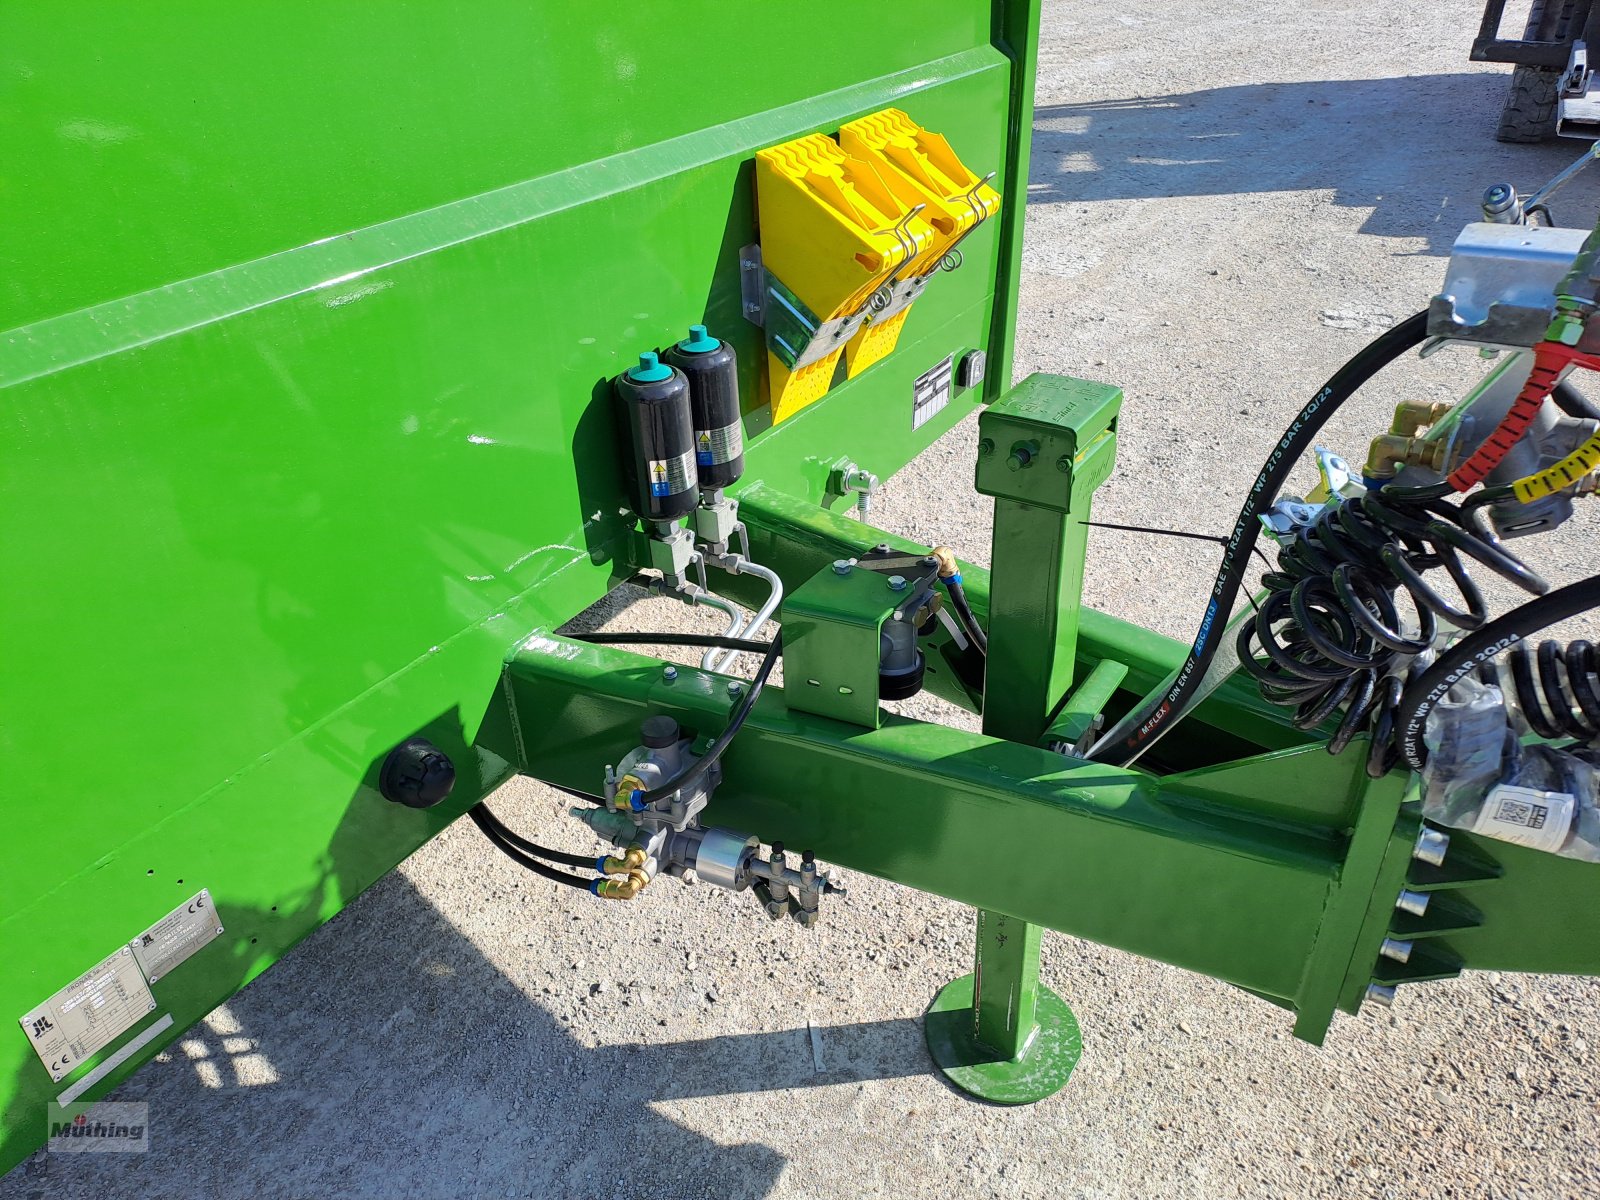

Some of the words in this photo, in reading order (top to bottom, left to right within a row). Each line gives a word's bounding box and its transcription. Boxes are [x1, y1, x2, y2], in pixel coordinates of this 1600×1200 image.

[1141, 706, 1167, 735] M-FLEX
[1168, 685, 1182, 702] DIN
[1177, 672, 1189, 688] EN
[1184, 657, 1196, 674] 857
[1195, 631, 1206, 652] 2SC
[1203, 604, 1216, 633] DN13
[1214, 571, 1227, 595] SAE
[1229, 520, 1246, 551] R2AT
[1254, 473, 1268, 493] WP
[1266, 450, 1283, 473] 275
[1280, 421, 1303, 450] BAR
[1301, 386, 1333, 421] 2Q/24
[1404, 736, 1417, 757] R2AT
[1414, 702, 1431, 718] WP
[1426, 683, 1449, 701] 275
[1444, 660, 1477, 683] BAR
